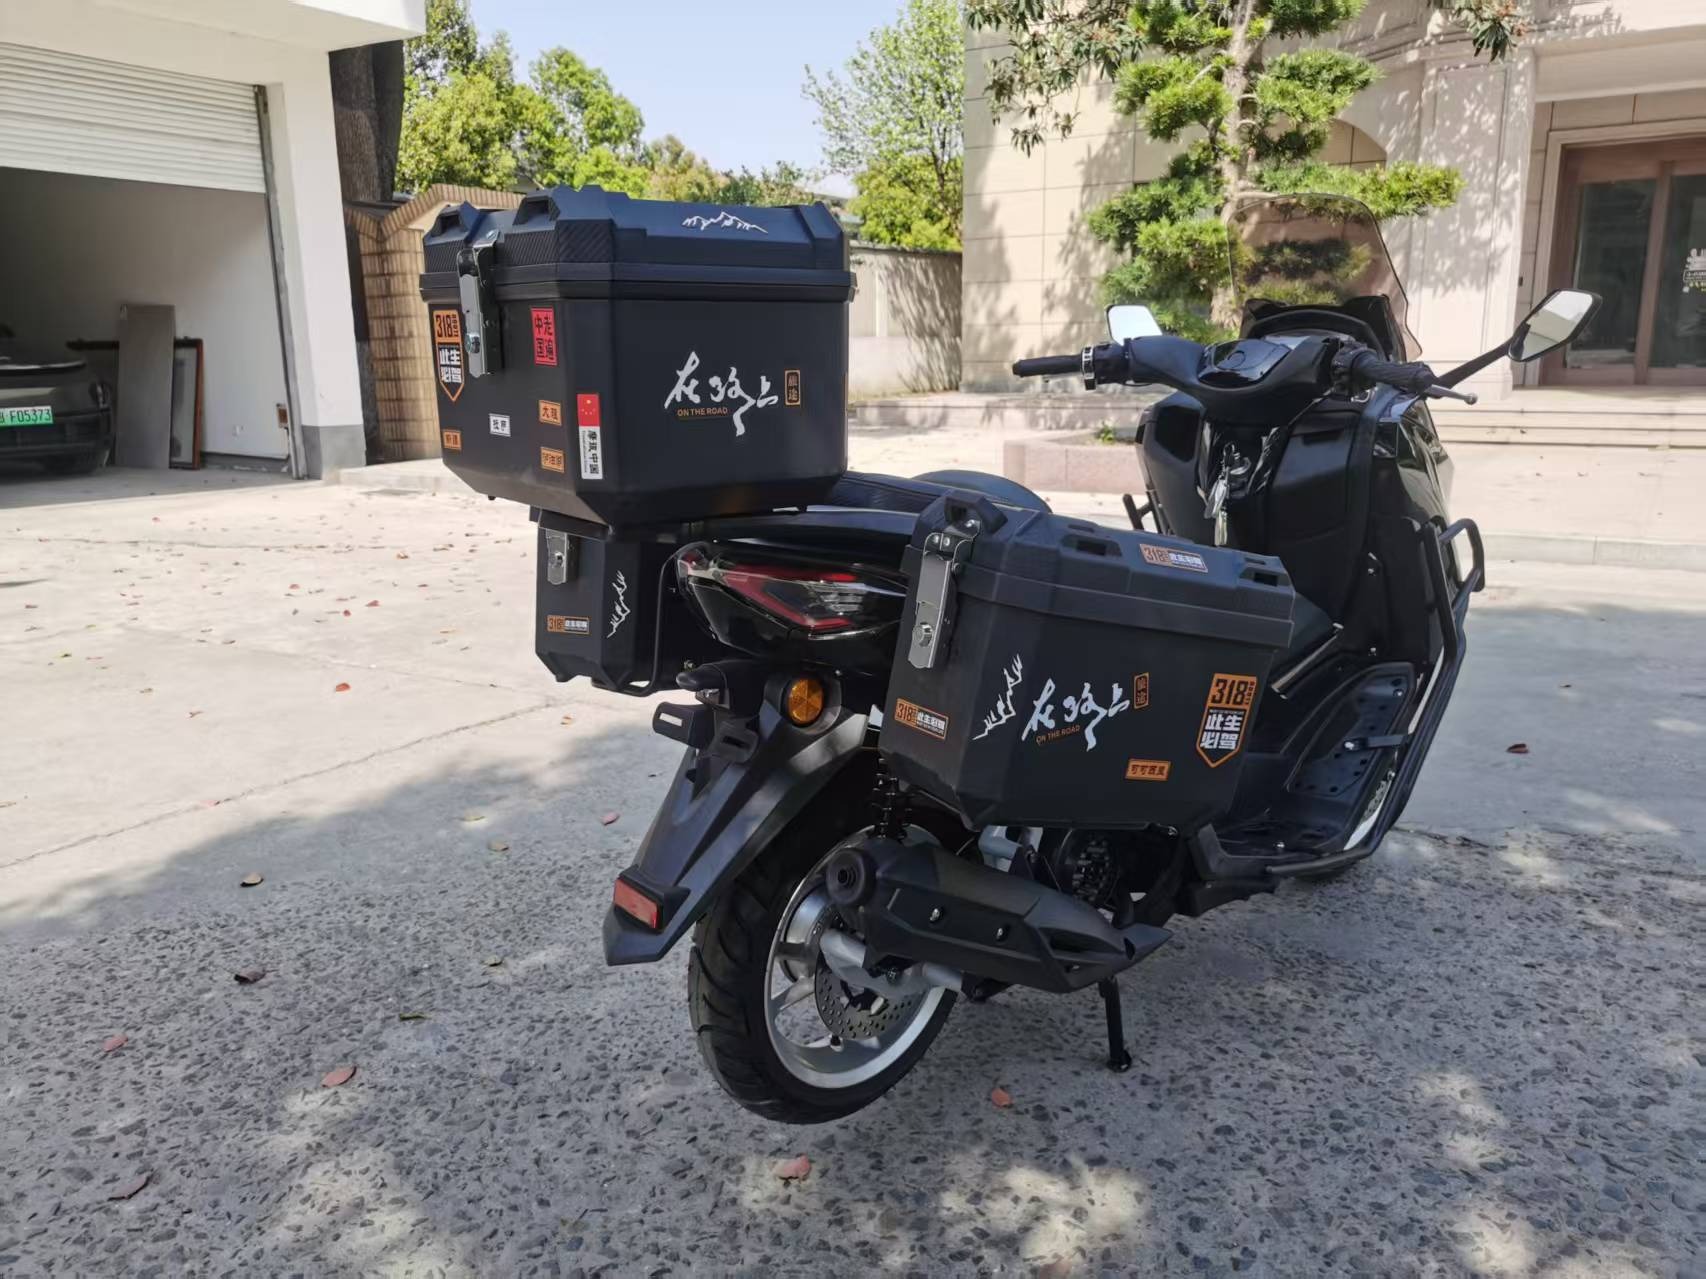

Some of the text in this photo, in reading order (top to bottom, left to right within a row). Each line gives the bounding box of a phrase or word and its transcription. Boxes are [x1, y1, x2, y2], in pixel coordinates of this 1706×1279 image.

[435, 314, 452, 338] 318
[439, 348, 461, 365] 此生
[677, 406, 729, 417] ON THE ROAD
[1211, 678, 1249, 705] 318
[897, 703, 913, 721] 318
[1205, 713, 1243, 732] 此生
[1047, 731, 1061, 741] THE
[1061, 724, 1081, 736] ROAD
[1200, 731, 1239, 750] 必驾
